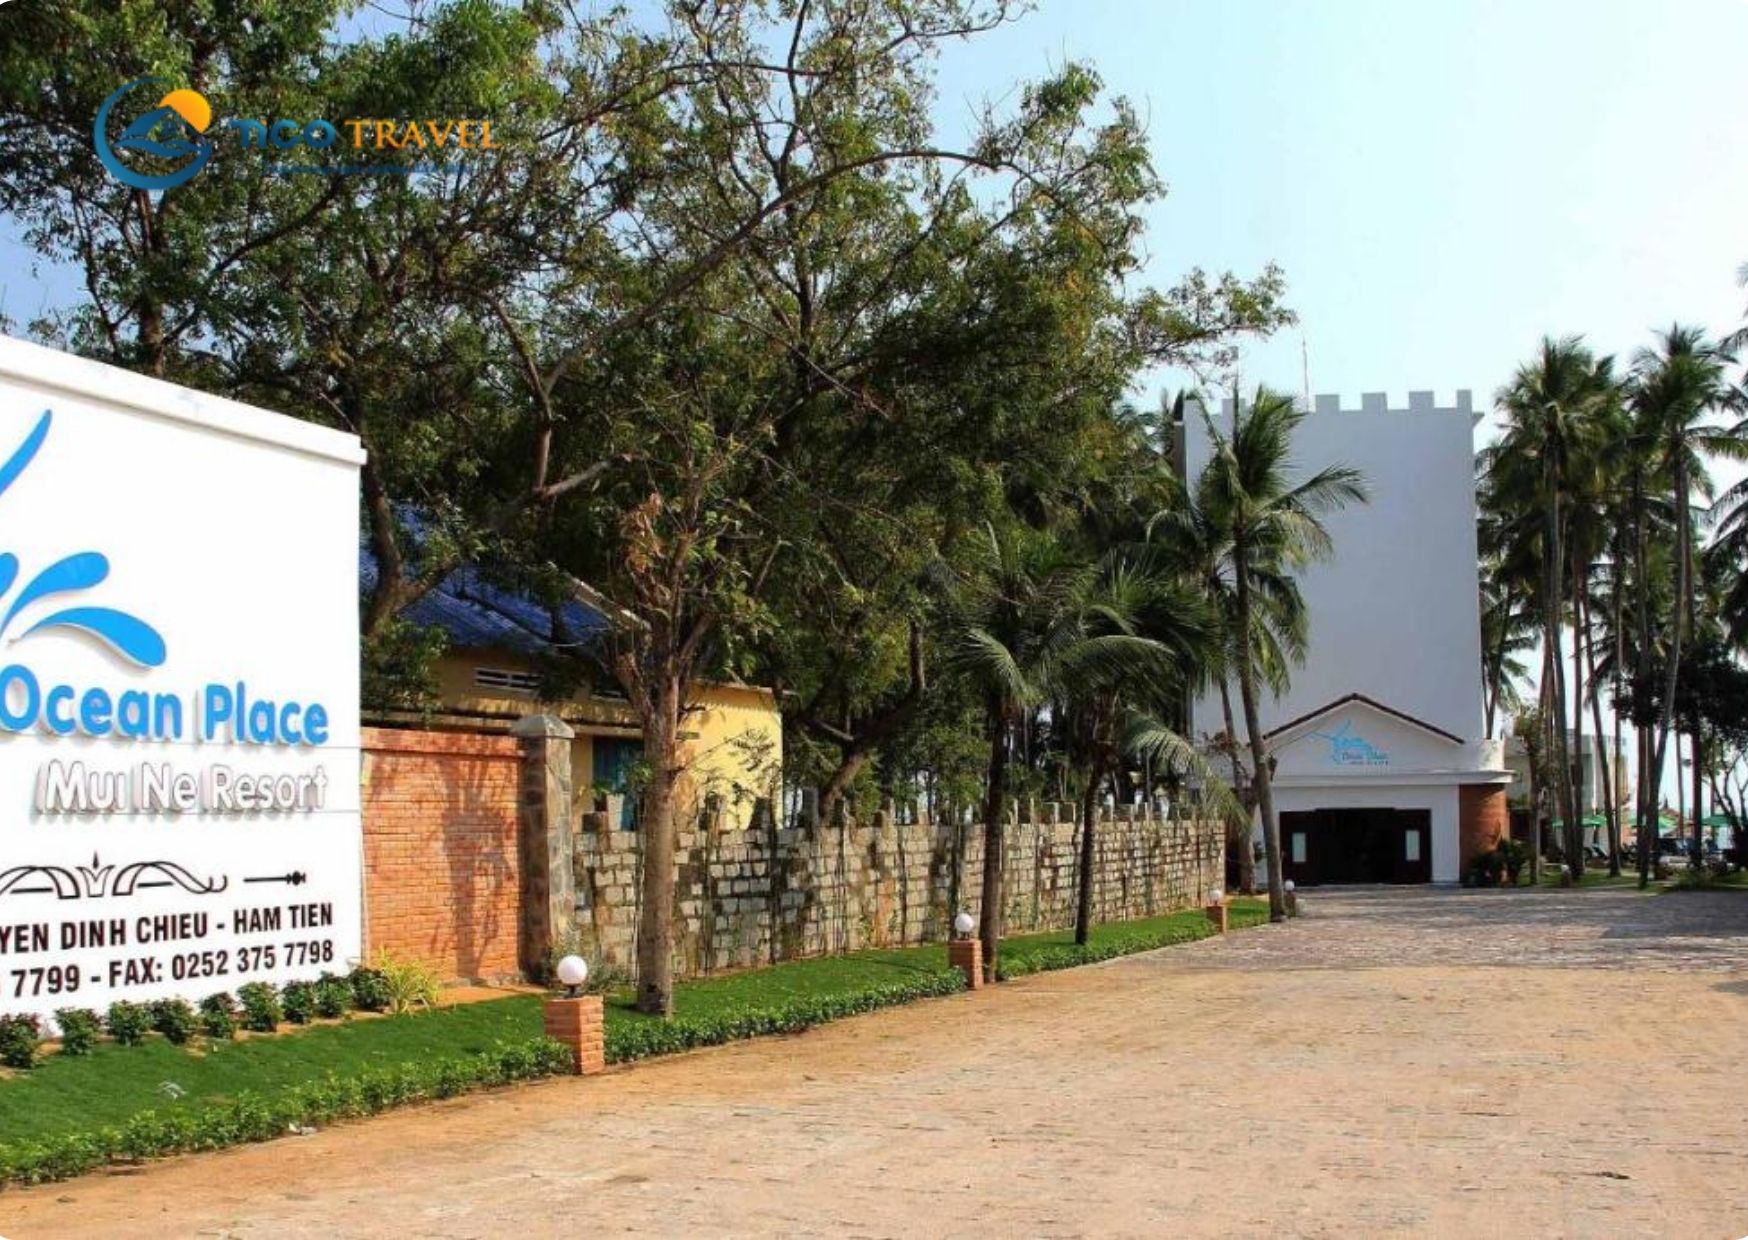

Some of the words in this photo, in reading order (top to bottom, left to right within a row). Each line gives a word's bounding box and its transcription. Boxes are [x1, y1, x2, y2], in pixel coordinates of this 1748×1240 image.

[0, 664, 182, 740] Ocean
[204, 681, 329, 744] Place
[141, 762, 197, 810] Ne
[210, 764, 327, 811] Resort
[60, 918, 126, 950] DINH
[136, 912, 208, 943] CHIEU
[233, 906, 281, 934] HAM
[288, 902, 332, 928] TIEN
[11, 964, 80, 998] 7799
[109, 956, 162, 988] FAX:
[172, 950, 228, 981] 0252
[237, 945, 276, 973] 375
[284, 939, 333, 967] 7798
